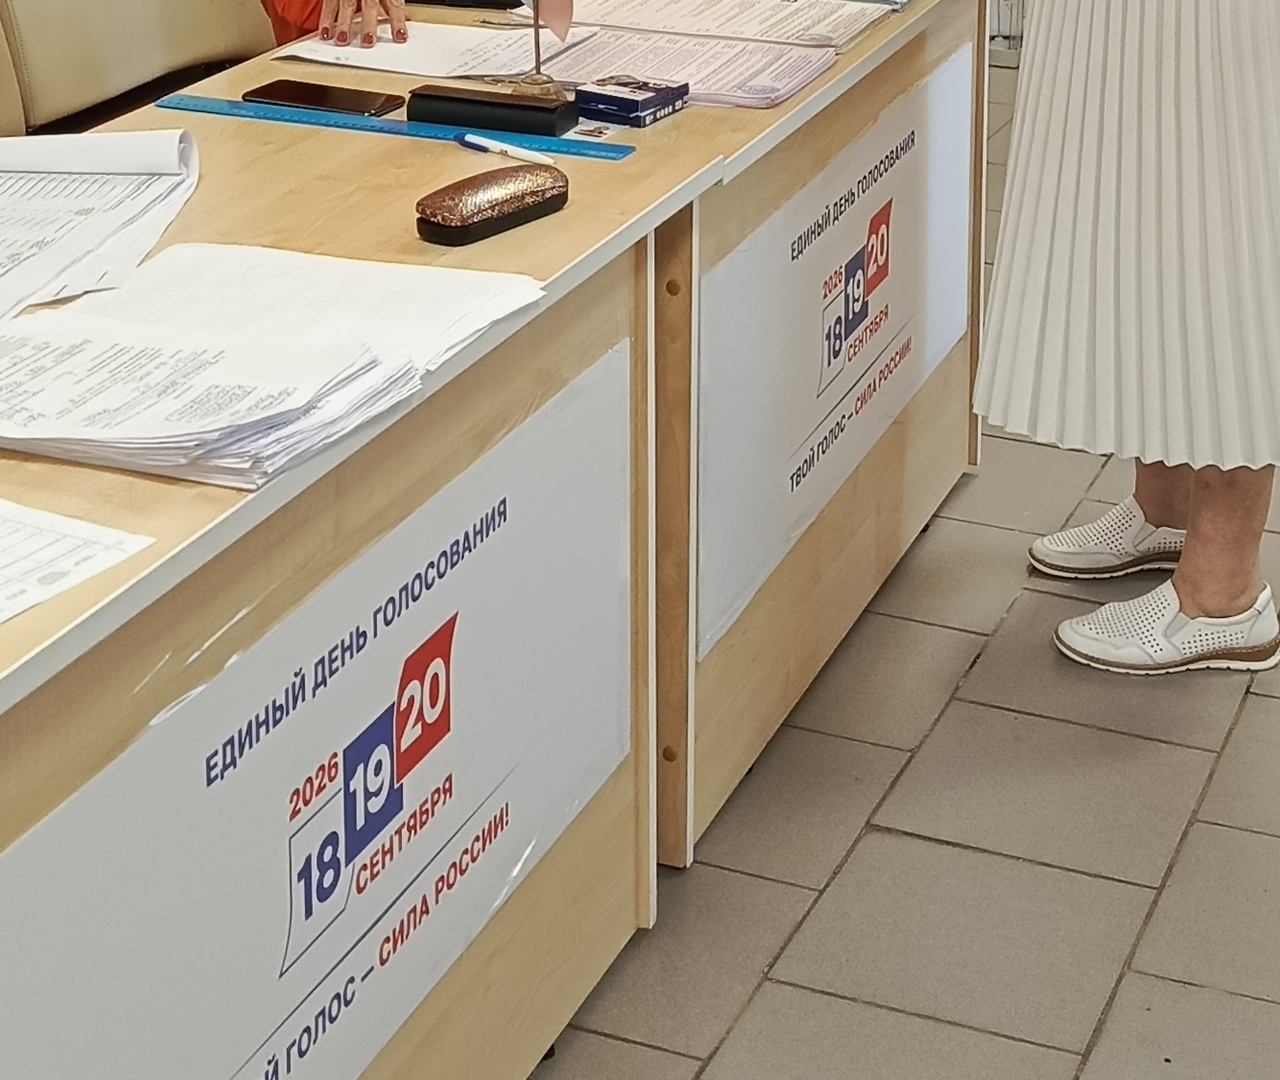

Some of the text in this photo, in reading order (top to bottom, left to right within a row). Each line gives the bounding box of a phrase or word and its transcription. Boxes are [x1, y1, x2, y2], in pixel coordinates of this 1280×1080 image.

[790, 129, 915, 262] ЕДИНЫЙ ДЕНЬ ГОЛОСОВАНИЯ
[822, 265, 843, 300] 2026
[825, 223, 888, 368] 18 19 20
[847, 303, 889, 362] СЕНТЯБРЯ
[789, 445, 815, 493] ТВОЙ
[816, 414, 846, 462] ГОЛОС
[854, 377, 877, 416] СИЛА
[878, 335, 912, 389] РОССИИ!
[205, 496, 508, 788] ЕДИНЫЙ ДЕНЬ ГОЛОСОВАНИЯ
[288, 751, 339, 823] 2026
[296, 656, 447, 921] 18 19 20
[355, 772, 454, 895] СЕНТЯБРЯ
[286, 975, 356, 1074] ГОЛОС
[378, 893, 430, 968] СИЛА
[434, 802, 510, 906] РОССИИ!
